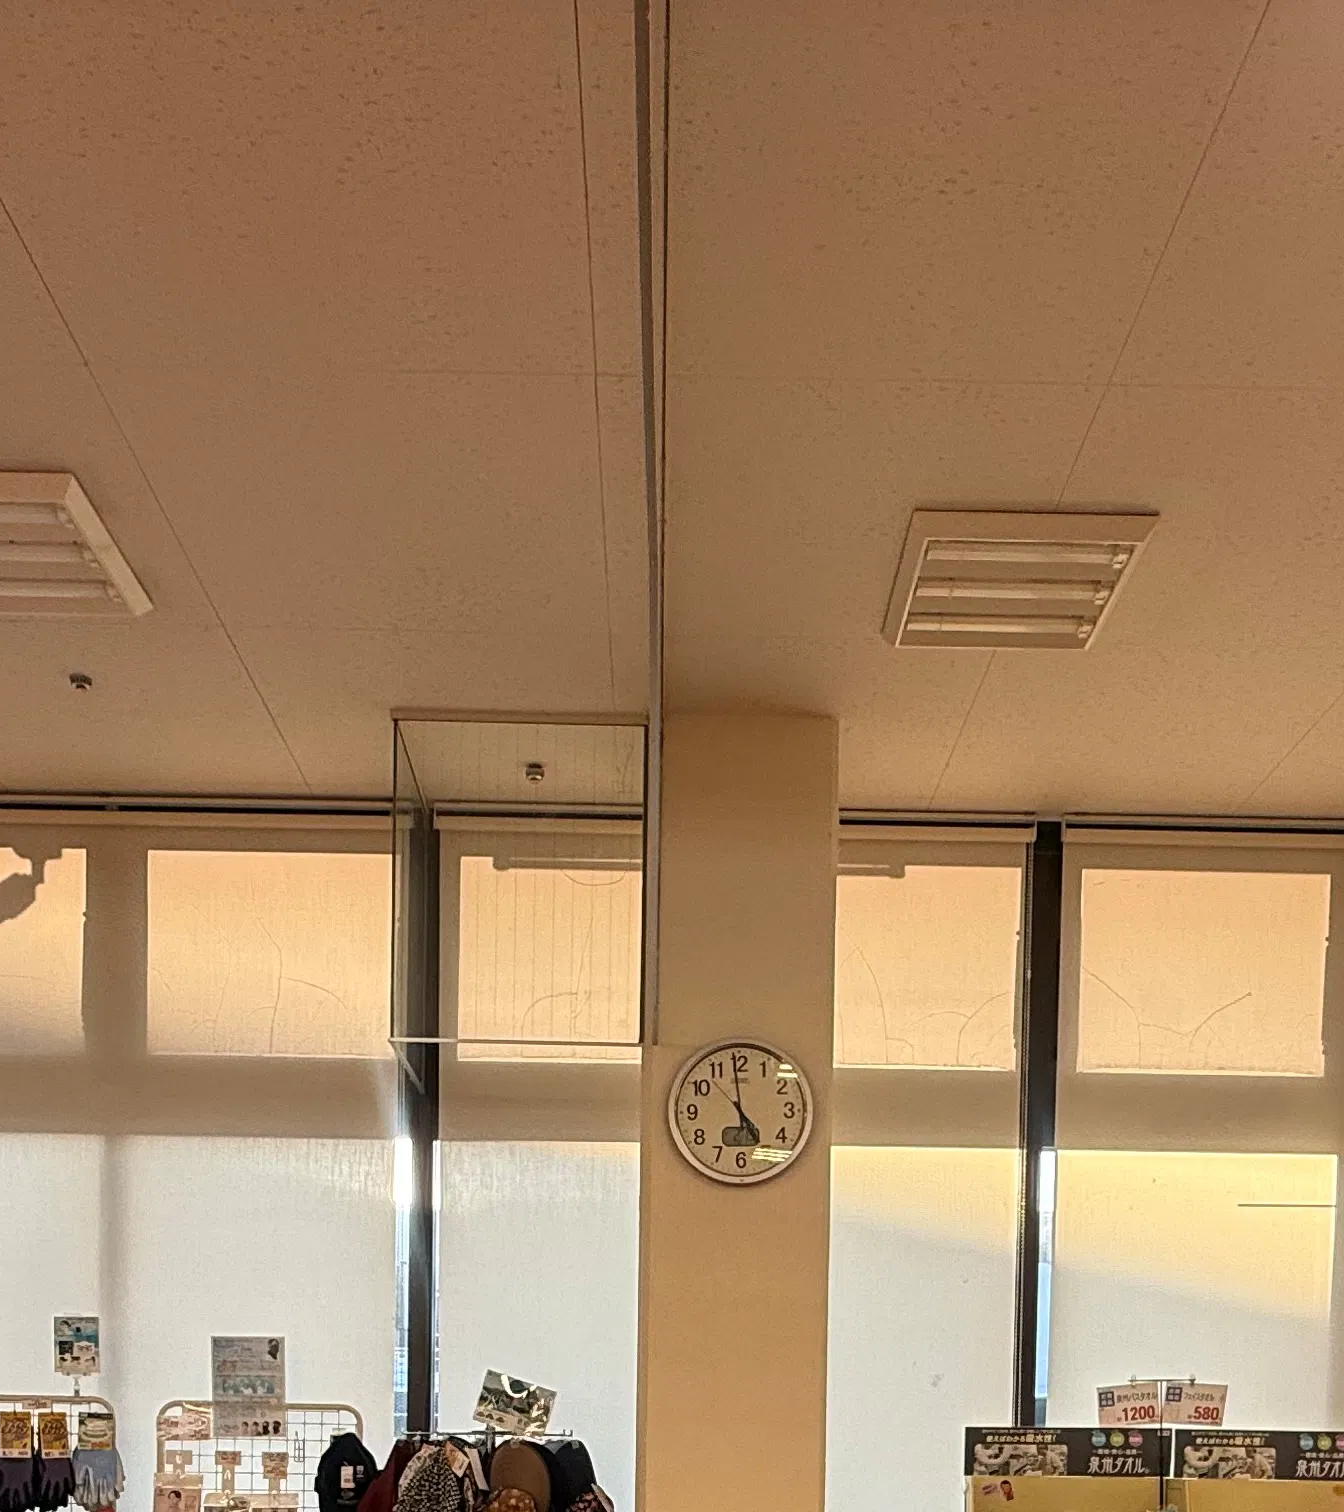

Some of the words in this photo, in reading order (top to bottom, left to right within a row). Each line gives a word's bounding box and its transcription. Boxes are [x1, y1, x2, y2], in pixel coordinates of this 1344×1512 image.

[709, 1061, 723, 1079] 11
[759, 1061, 766, 1078] 1
[693, 1079, 711, 1097] 10
[776, 1078, 789, 1095] 2
[686, 1103, 699, 1121] 9
[783, 1102, 795, 1119] 3
[693, 1128, 706, 1146] 8
[775, 1126, 788, 1144] 4
[712, 1145, 724, 1163] 7
[735, 1151, 748, 1169] 6
[1122, 1405, 1156, 1421] 1200
[1193, 1406, 1220, 1420] 580
